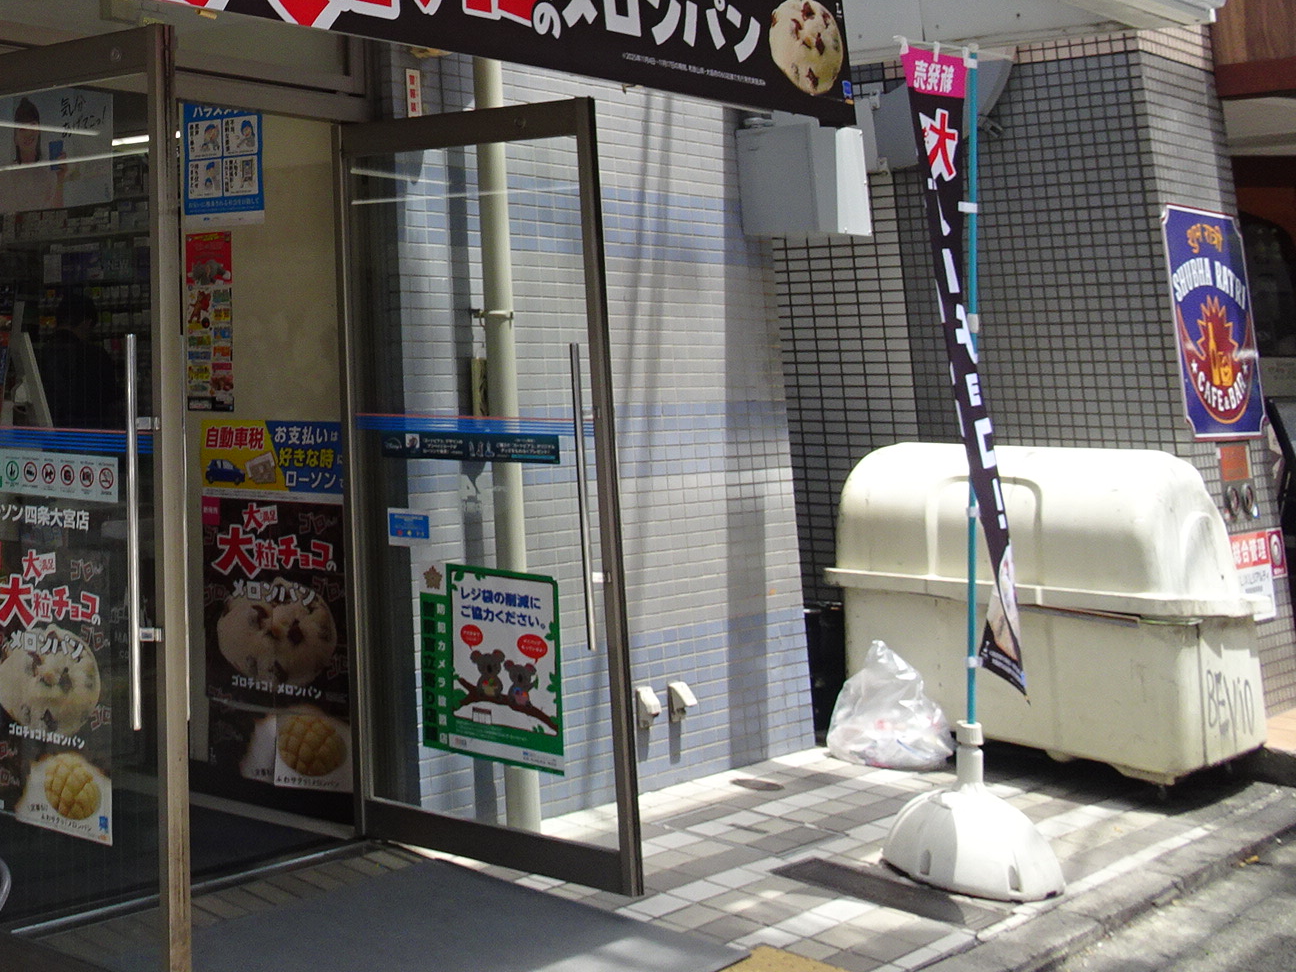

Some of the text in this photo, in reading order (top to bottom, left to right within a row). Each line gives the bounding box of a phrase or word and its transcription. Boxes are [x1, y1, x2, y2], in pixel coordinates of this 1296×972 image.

[1172, 257, 1246, 311] SHUBHA RATRI
[205, 426, 265, 450] 自動車税
[232, 578, 317, 606] メロンパン
[460, 586, 542, 610] レジ袋の削減に
[460, 604, 546, 630] ご協力ください。
[10, 629, 84, 660] メロンパン
